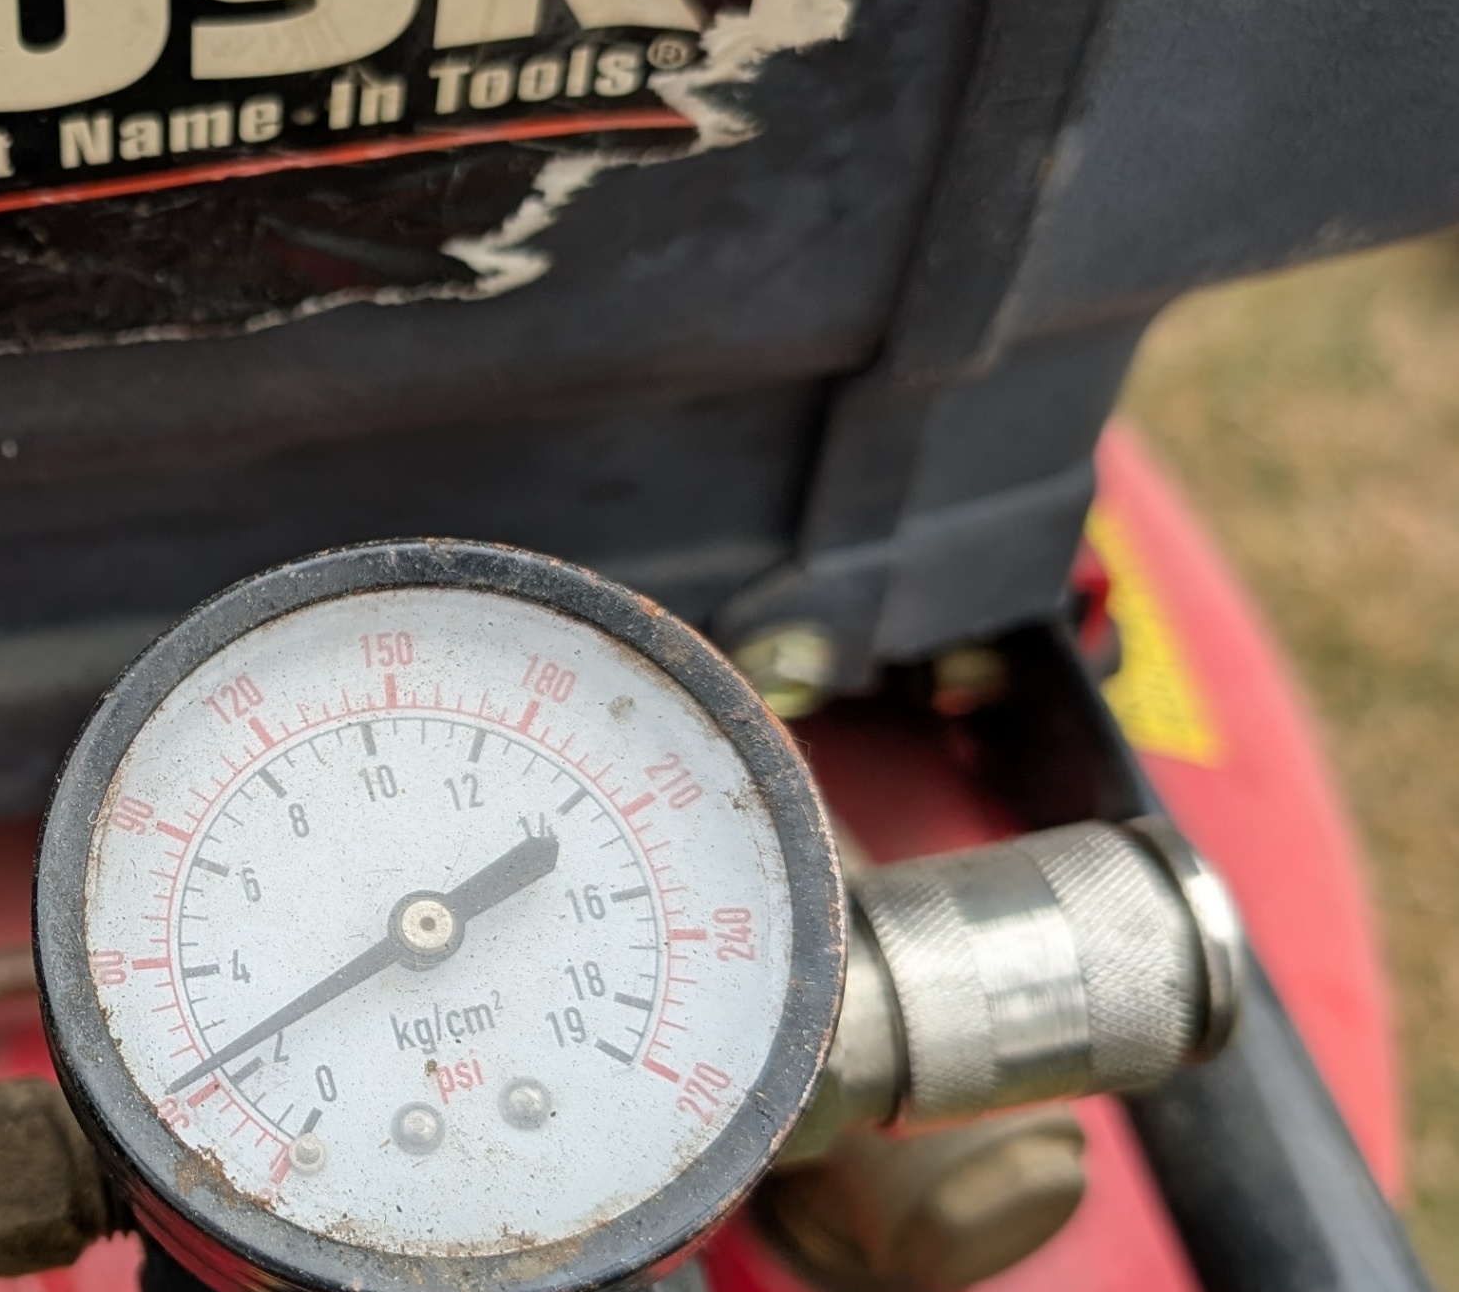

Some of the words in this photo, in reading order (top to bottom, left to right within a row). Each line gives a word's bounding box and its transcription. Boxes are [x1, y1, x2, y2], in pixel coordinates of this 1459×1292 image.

[59, 95, 282, 169] Name
[328, 72, 406, 130] In
[360, 631, 414, 668] 150
[206, 674, 264, 726] 120
[521, 654, 576, 706] 180
[359, 764, 398, 804] 10
[445, 773, 484, 813] 12
[645, 753, 703, 812] 210
[112, 796, 154, 834] 90
[289, 804, 310, 838] 8
[242, 866, 262, 903] 6
[564, 884, 607, 924] 16
[712, 907, 755, 963] 240
[232, 948, 251, 984] 4
[564, 961, 606, 1001] 18
[545, 1006, 587, 1048] 19
[315, 1064, 338, 1103] 0
[435, 1049, 484, 1105] psi
[677, 1062, 730, 1125] 270
